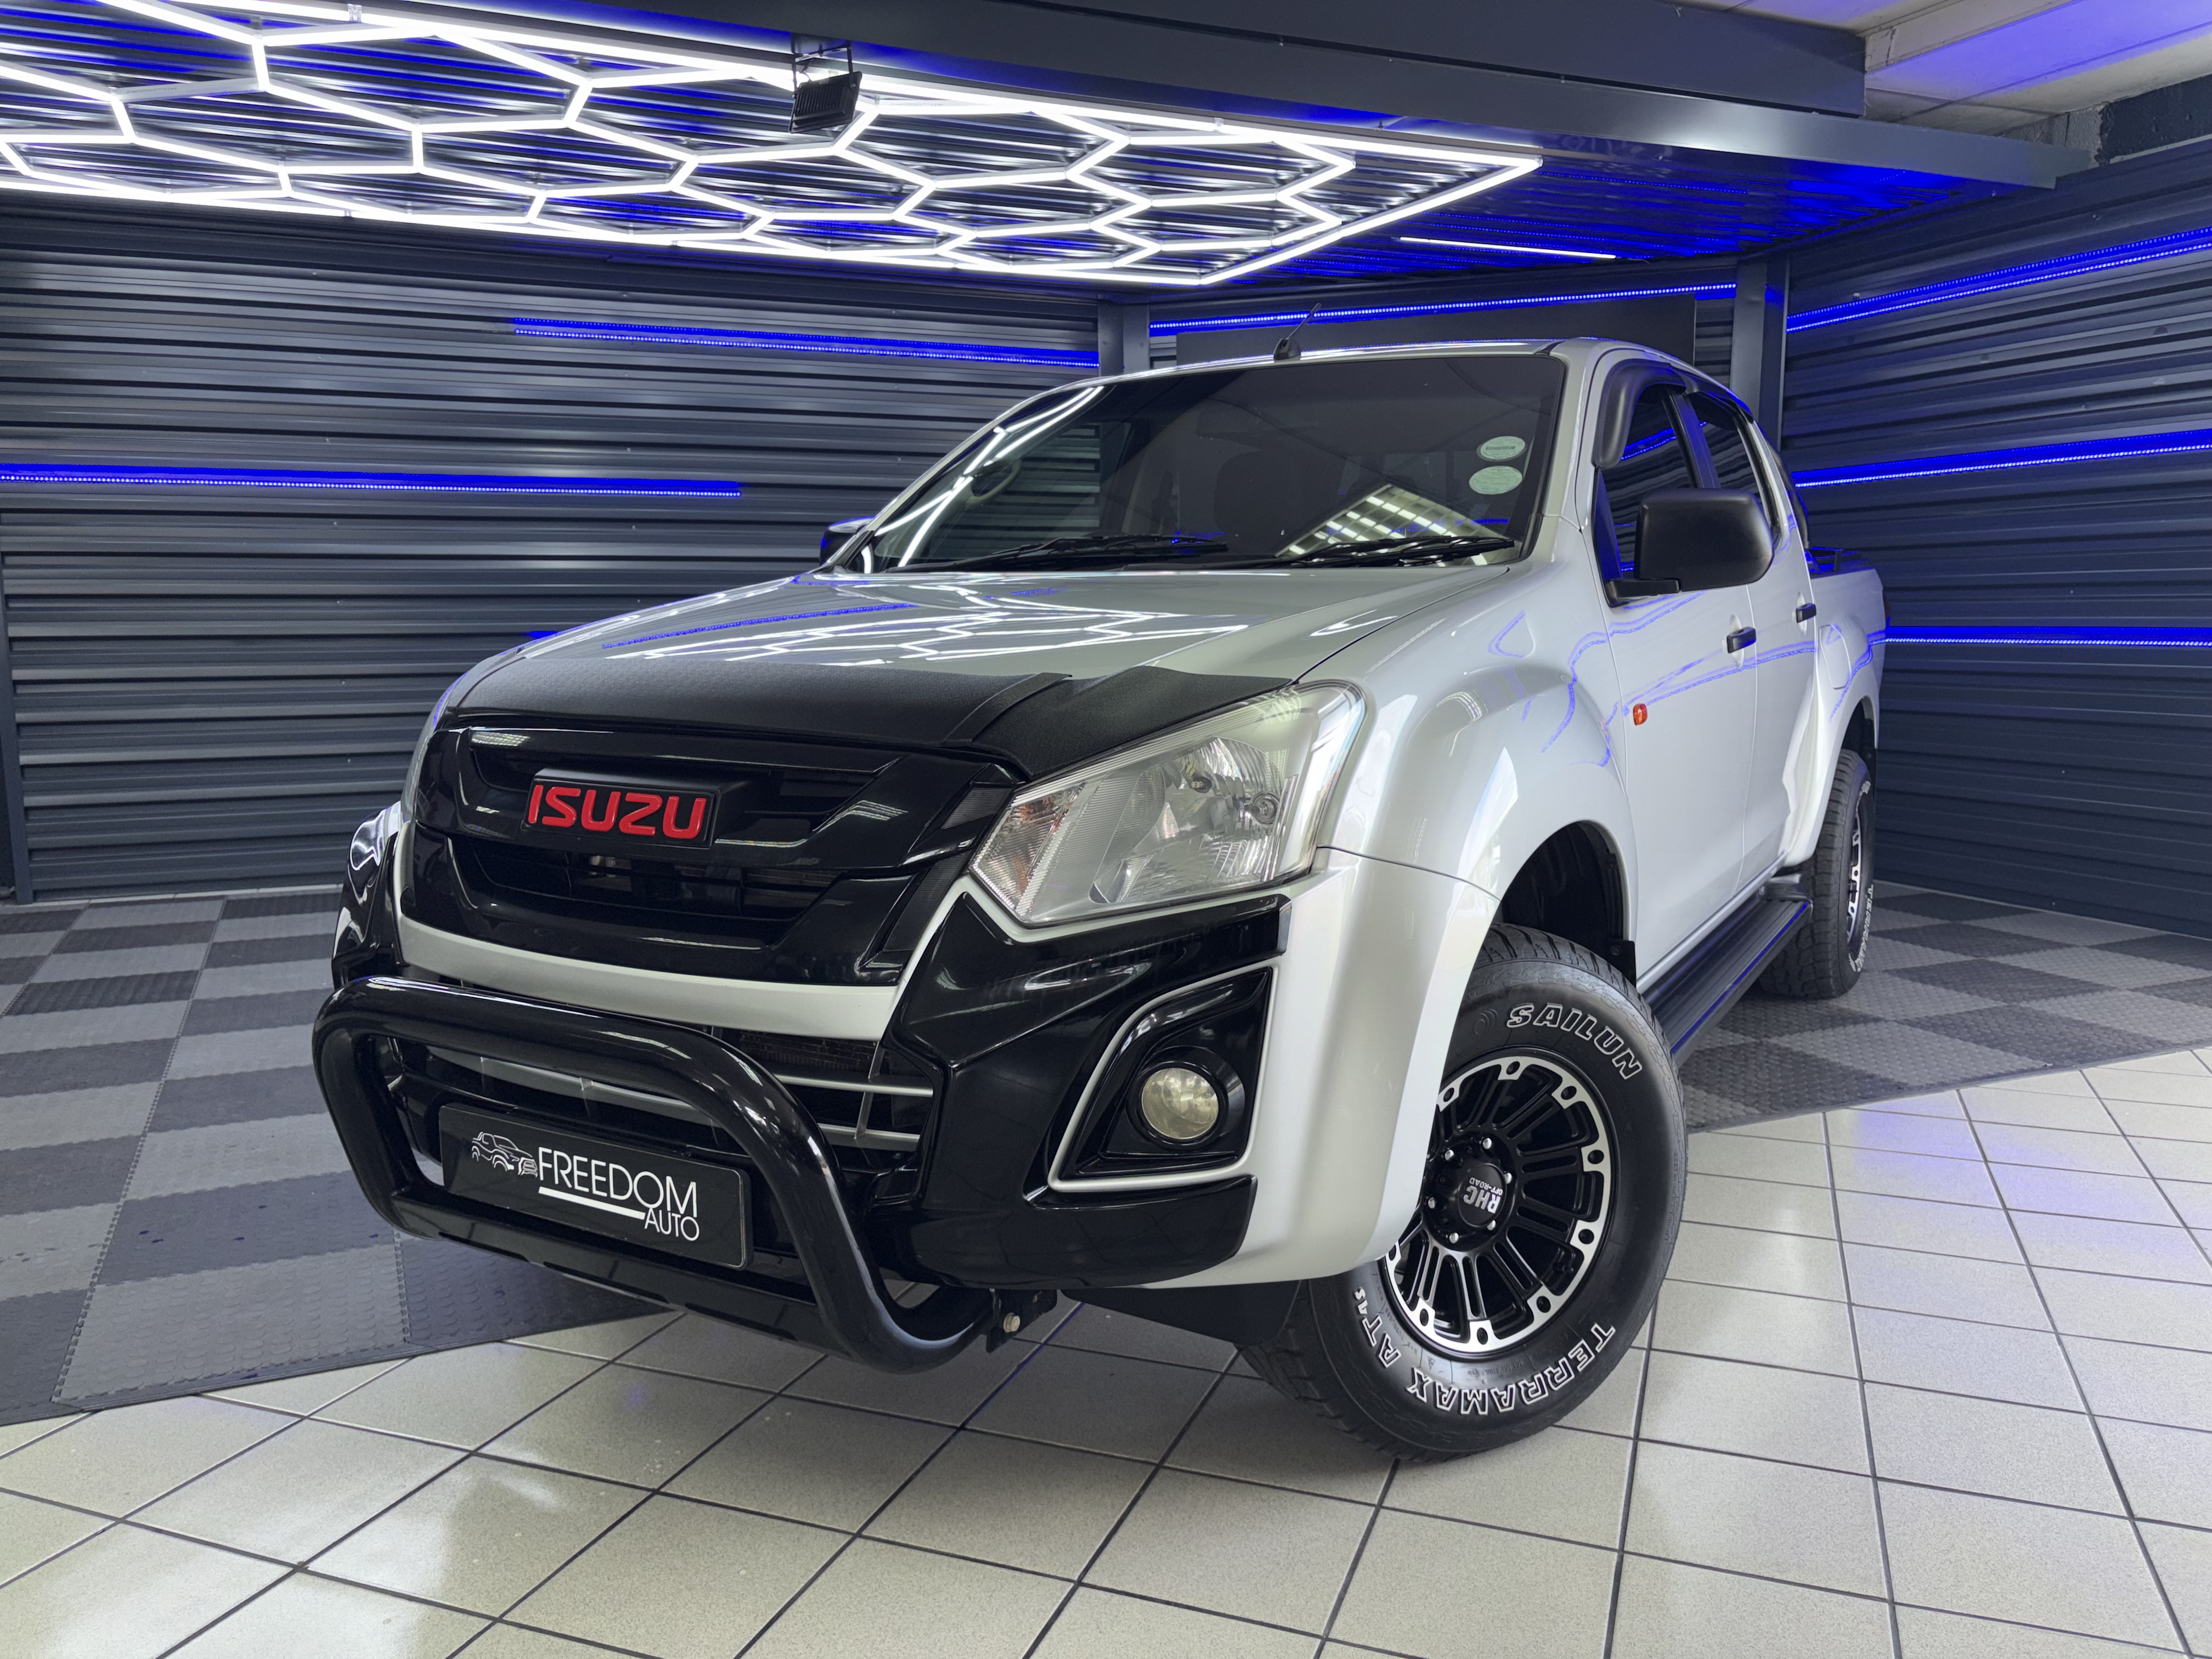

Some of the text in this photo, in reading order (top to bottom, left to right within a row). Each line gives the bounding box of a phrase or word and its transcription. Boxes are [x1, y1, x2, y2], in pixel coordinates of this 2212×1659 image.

[528, 785, 707, 839] ISUZU
[1506, 1003, 1643, 1080] SAILUN
[538, 1146, 697, 1217] FREEDOM
[1463, 1185, 1501, 1214] RHC
[1469, 1177, 1503, 1195] OFF-ROAD
[644, 1207, 699, 1241] AUTO
[1406, 1323, 1616, 1415] TERRAMAX
